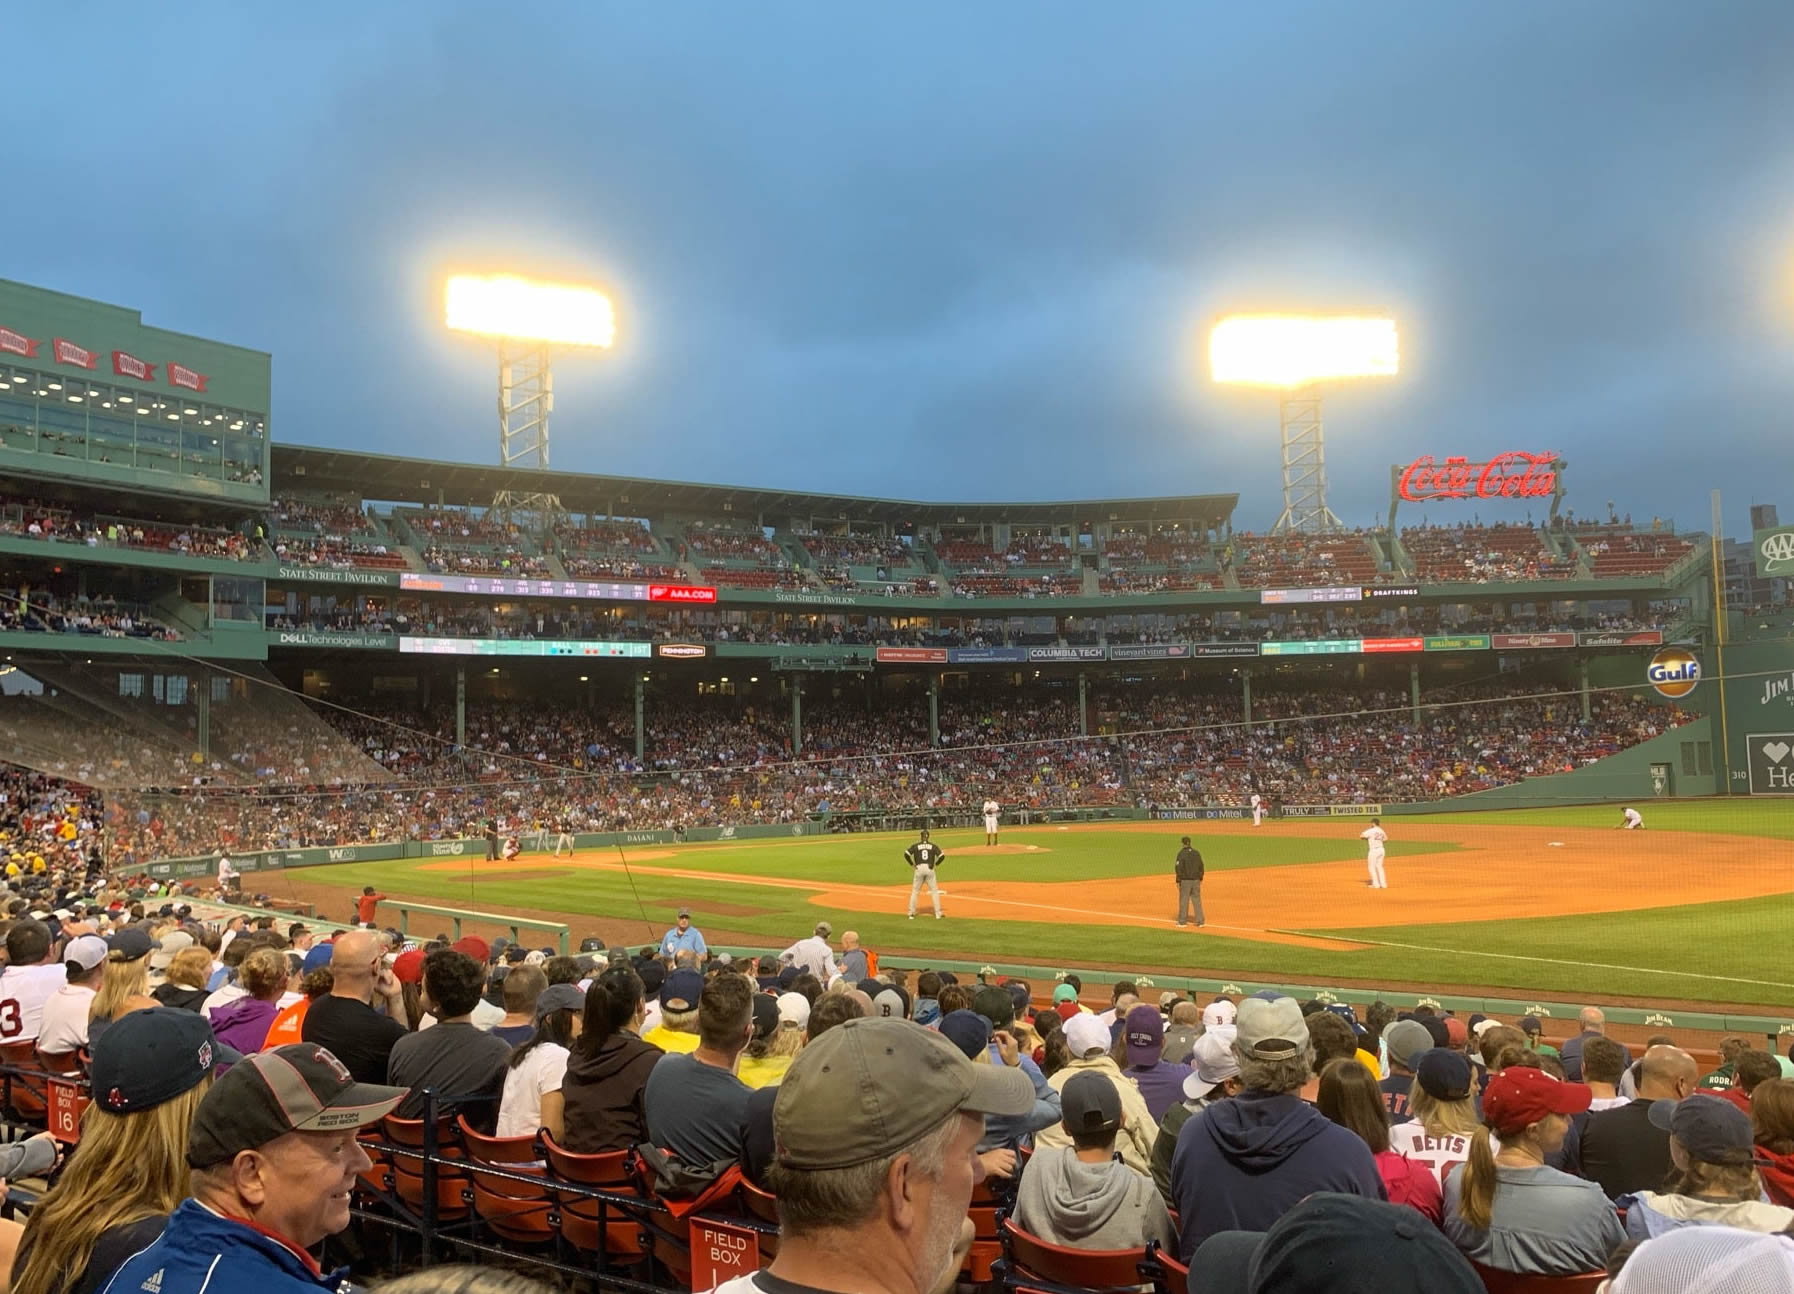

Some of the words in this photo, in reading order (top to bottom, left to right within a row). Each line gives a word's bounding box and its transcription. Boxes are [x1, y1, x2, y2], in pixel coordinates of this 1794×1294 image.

[1399, 451, 1560, 501] Coca-Cola
[280, 568, 307, 579] STATE
[309, 570, 342, 581] STREET
[345, 571, 388, 584] PAVILION
[670, 590, 713, 599] AAA.COM
[776, 592, 796, 602] STATE
[798, 593, 821, 603] STREET
[823, 595, 855, 604] PAVILION
[308, 634, 361, 647] Technologies
[364, 637, 386, 647] Level
[1031, 649, 1077, 657] COLUMBIA
[1079, 649, 1102, 657] TECH
[1114, 648, 1146, 657] vineyard
[1146, 648, 1166, 656] vines
[1205, 647, 1227, 655] Museum
[1650, 663, 1697, 682] Gulf
[1761, 678, 1789, 704] JIM
[1732, 771, 1746, 779] 310
[1173, 811, 1197, 819] Mitel
[1219, 810, 1243, 819] Mitel
[1285, 807, 1309, 815] TRULY
[627, 834, 654, 842] DASANI
[921, 849, 929, 860] 8
[882, 1003, 891, 1017] B
[1525, 1006, 1535, 1015] JIM
[1536, 1005, 1550, 1016] BEAM
[1216, 1016, 1223, 1025] B
[1645, 1015, 1656, 1025] JIM
[1656, 1013, 1673, 1025] BEAM
[1778, 1024, 1791, 1034] JIM
[55, 1085, 74, 1099] FIELD
[58, 1097, 72, 1109] BOX
[59, 1111, 73, 1132] 16
[320, 1112, 359, 1121] BOSTON
[1412, 1134, 1466, 1154] BETTS
[705, 1230, 747, 1251] FIELD
[711, 1247, 742, 1266] BOX
[140, 1281, 162, 1294] adidas
